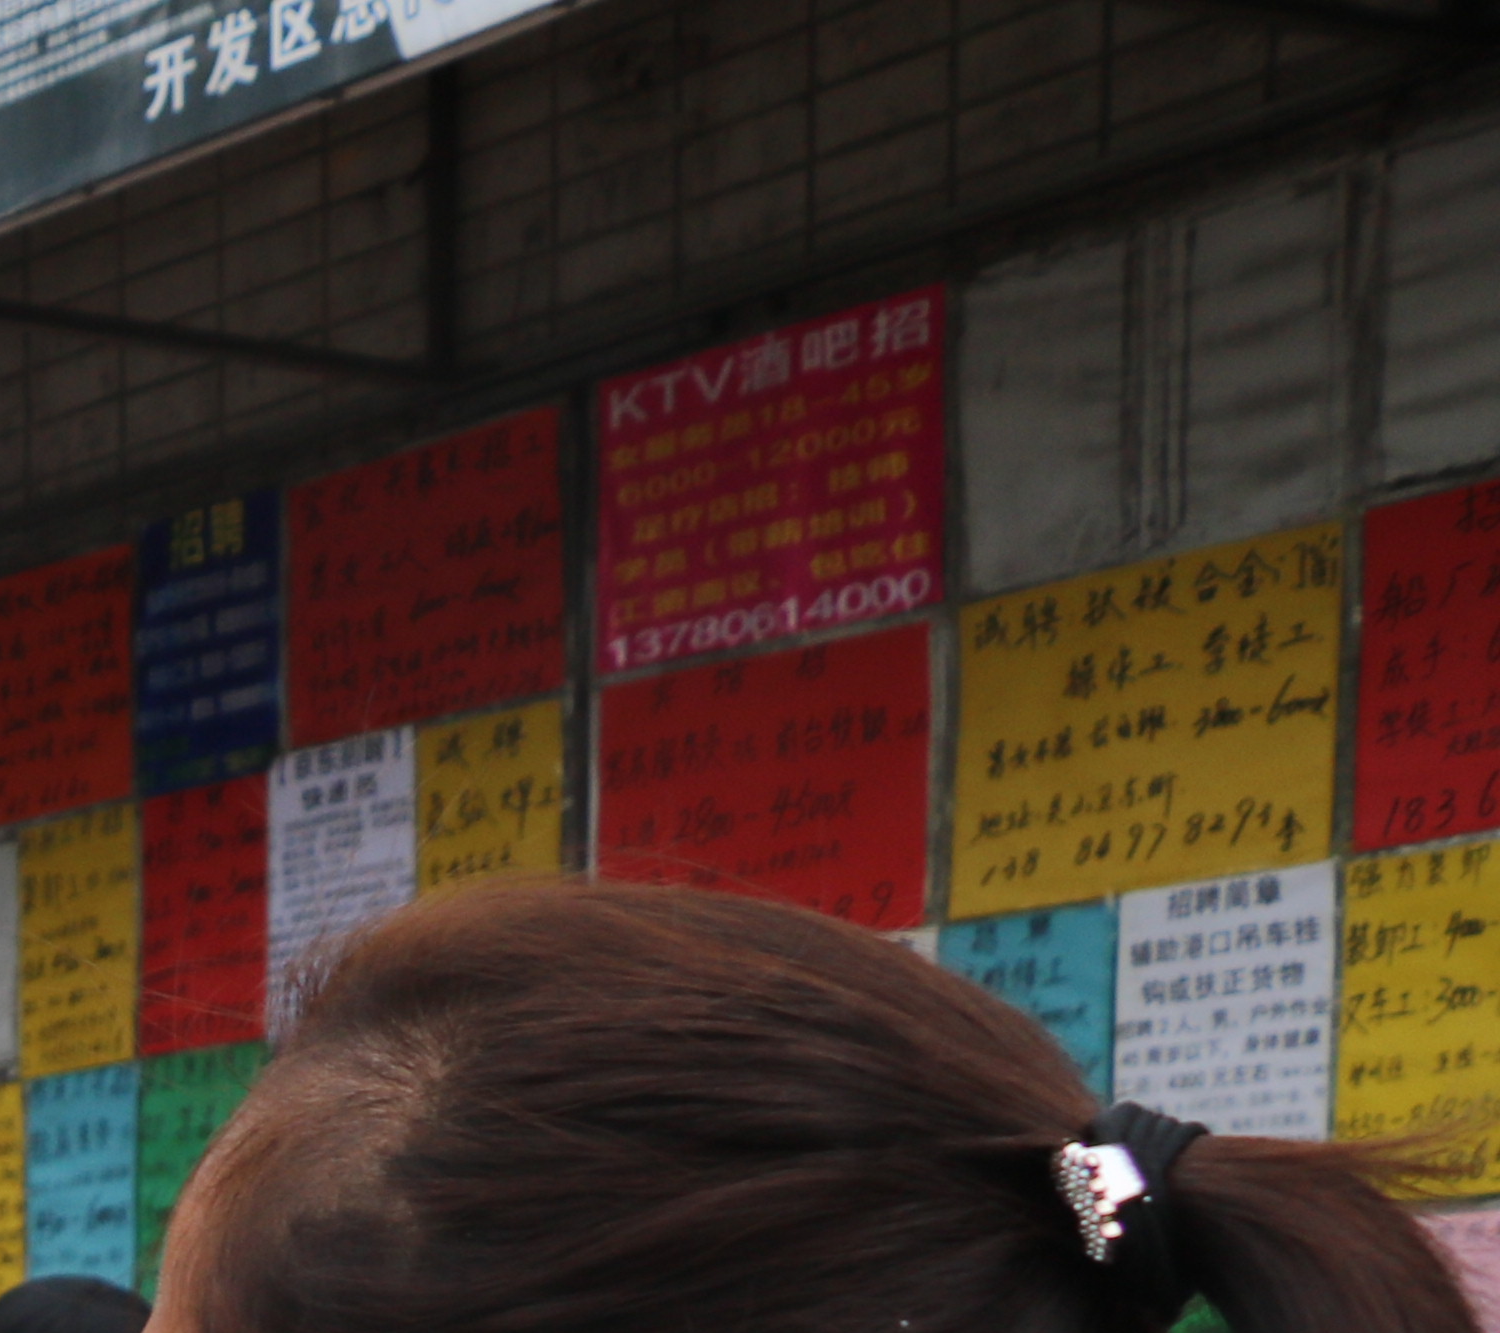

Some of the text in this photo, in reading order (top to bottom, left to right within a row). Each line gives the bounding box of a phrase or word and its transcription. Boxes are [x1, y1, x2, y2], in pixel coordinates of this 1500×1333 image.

[609, 298, 931, 430] KTV酒吧招
[606, 569, 932, 668] 13780614000
[1169, 876, 1282, 919] 招聘简章
